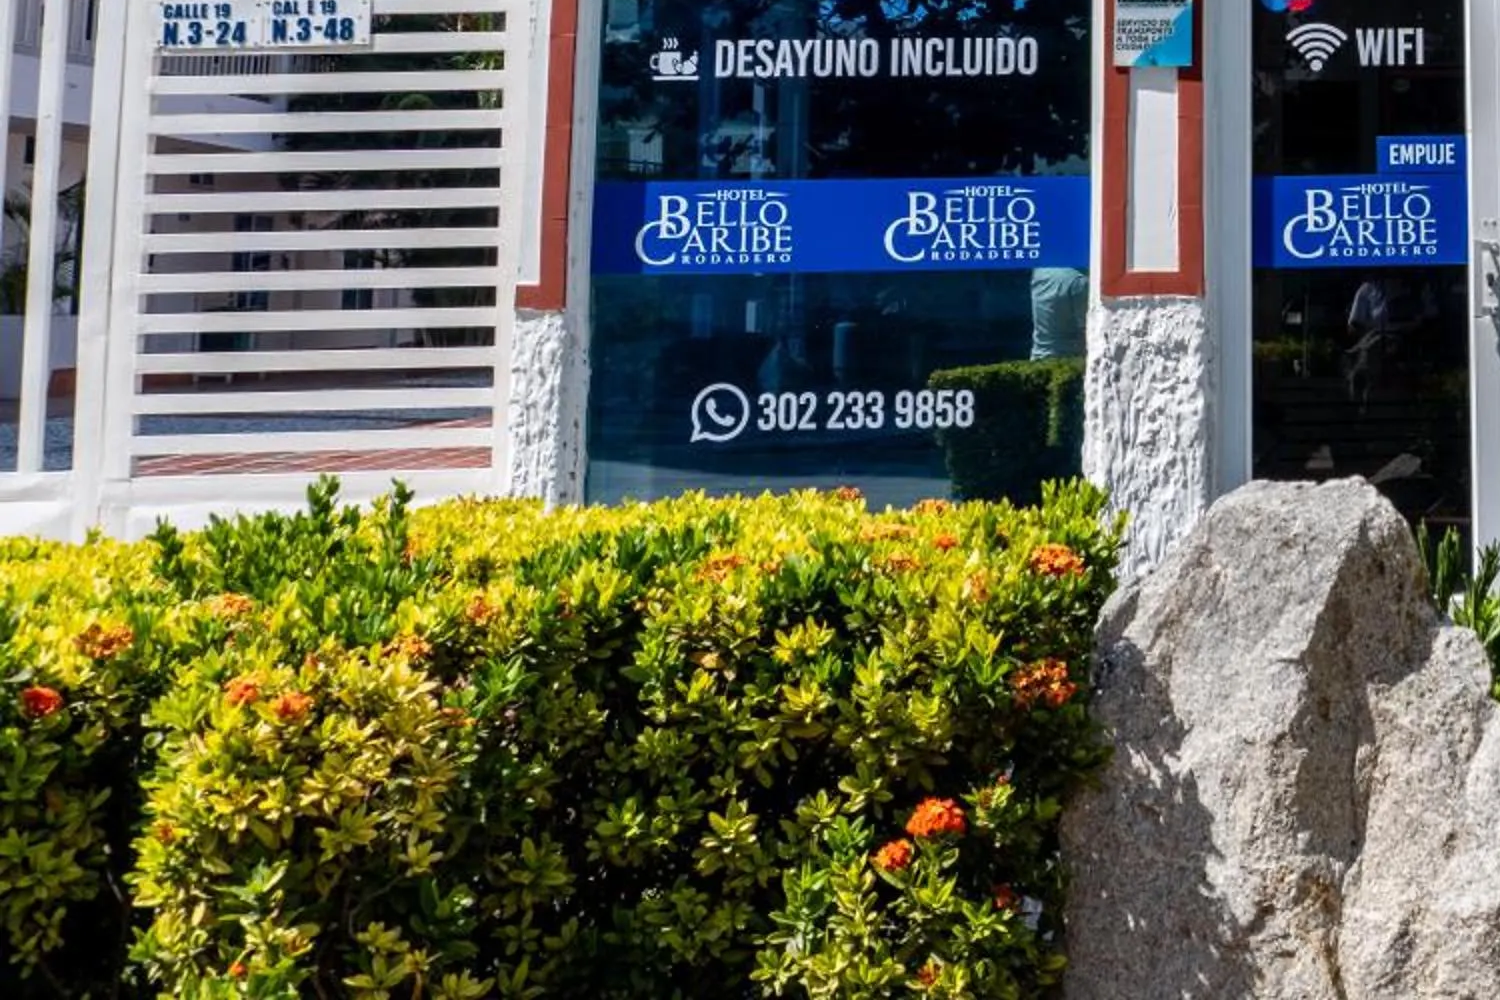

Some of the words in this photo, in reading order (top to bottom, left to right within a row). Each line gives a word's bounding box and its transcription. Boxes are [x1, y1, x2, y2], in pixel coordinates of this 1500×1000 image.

[163, 4, 208, 20] CALLE
[214, 3, 231, 18] 19
[319, 0, 337, 15] 19
[163, 21, 246, 46] N.3-24
[272, 17, 354, 42] N.3-48
[715, 39, 879, 78] DESAYUNO
[890, 37, 1038, 76] INCLUIDO
[1355, 27, 1424, 66] WIFI
[1389, 143, 1456, 165] EMPUJE
[716, 189, 767, 201] HOTEL
[964, 185, 1014, 197] HOTEL
[1361, 182, 1411, 195] HOTEL
[658, 195, 788, 239] BELLO
[907, 191, 1036, 235] BELLO
[1304, 189, 1431, 233] BELLO
[635, 220, 793, 266] CARIBE
[883, 217, 1040, 263] CARIBE
[1283, 214, 1437, 259] CARIBE
[681, 253, 793, 265] RODADERO
[930, 249, 1040, 262] RODADERO
[1329, 245, 1437, 257] RODADERO
[757, 392, 817, 431] 302
[826, 391, 885, 430] 233
[895, 389, 975, 429] 9858
